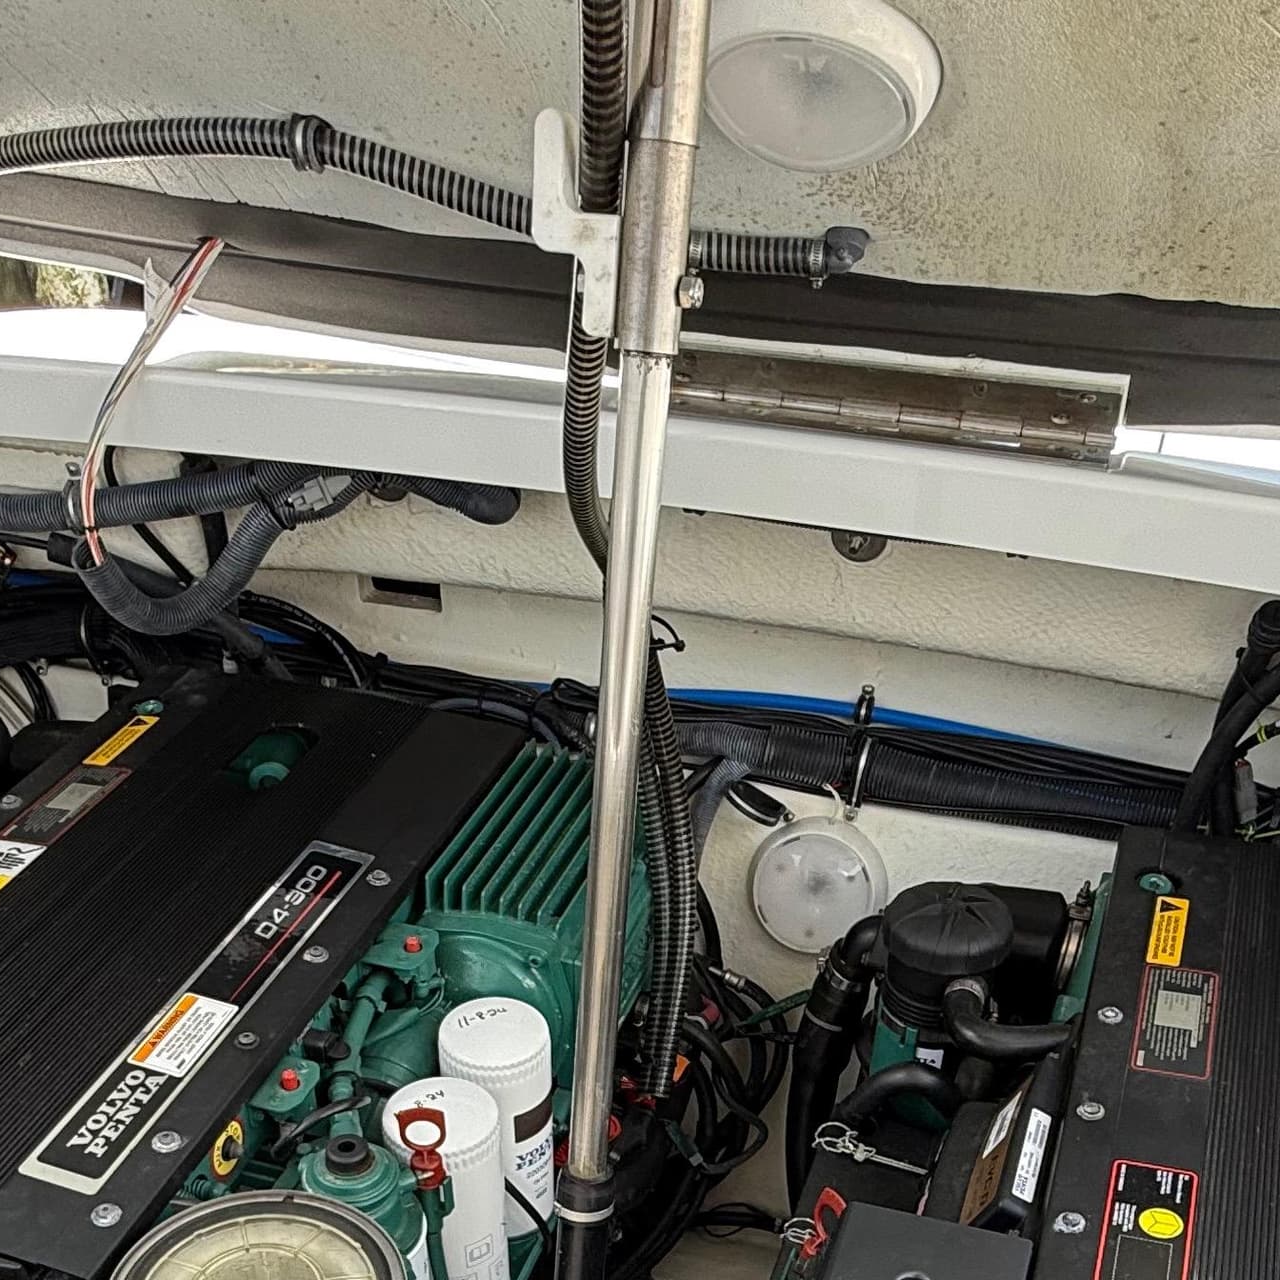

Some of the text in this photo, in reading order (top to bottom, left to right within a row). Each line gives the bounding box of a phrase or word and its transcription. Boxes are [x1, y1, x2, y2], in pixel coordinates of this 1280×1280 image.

[255, 865, 327, 939] D4-300
[153, 1009, 185, 1043] WARNING
[66, 1070, 146, 1148] VOLVO
[83, 1074, 169, 1158] PENTA
